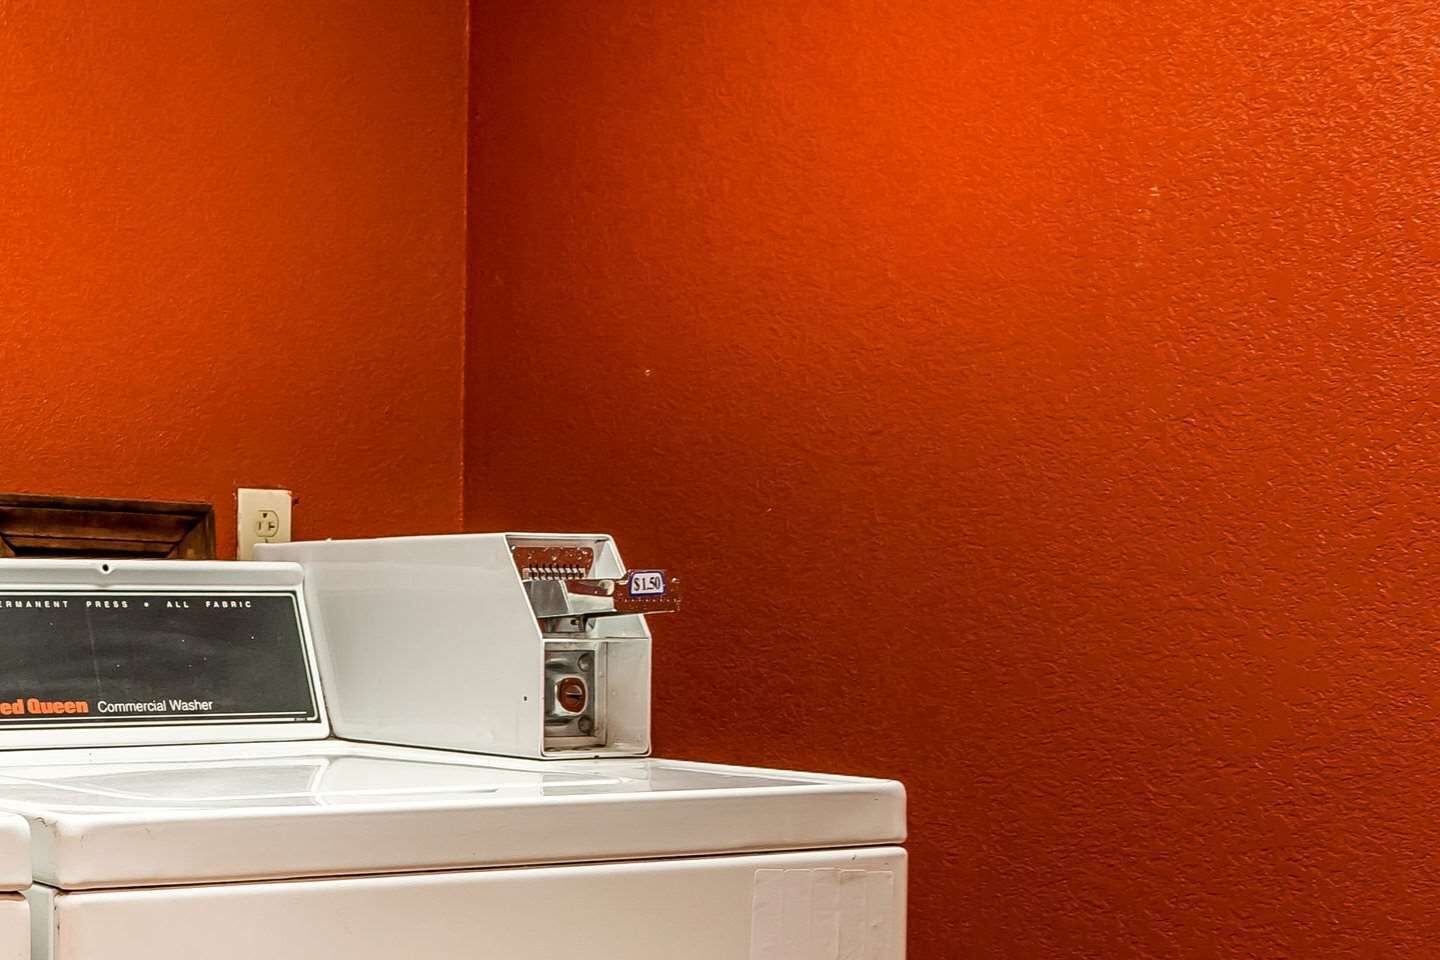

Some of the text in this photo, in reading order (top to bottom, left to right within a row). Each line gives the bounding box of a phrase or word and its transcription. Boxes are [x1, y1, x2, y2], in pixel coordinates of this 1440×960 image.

[86, 600, 129, 608] PRESS
[166, 600, 190, 608] ALL
[205, 600, 252, 608] FABRIC
[27, 698, 90, 714] Queen
[97, 699, 213, 713] Commercial Washer
